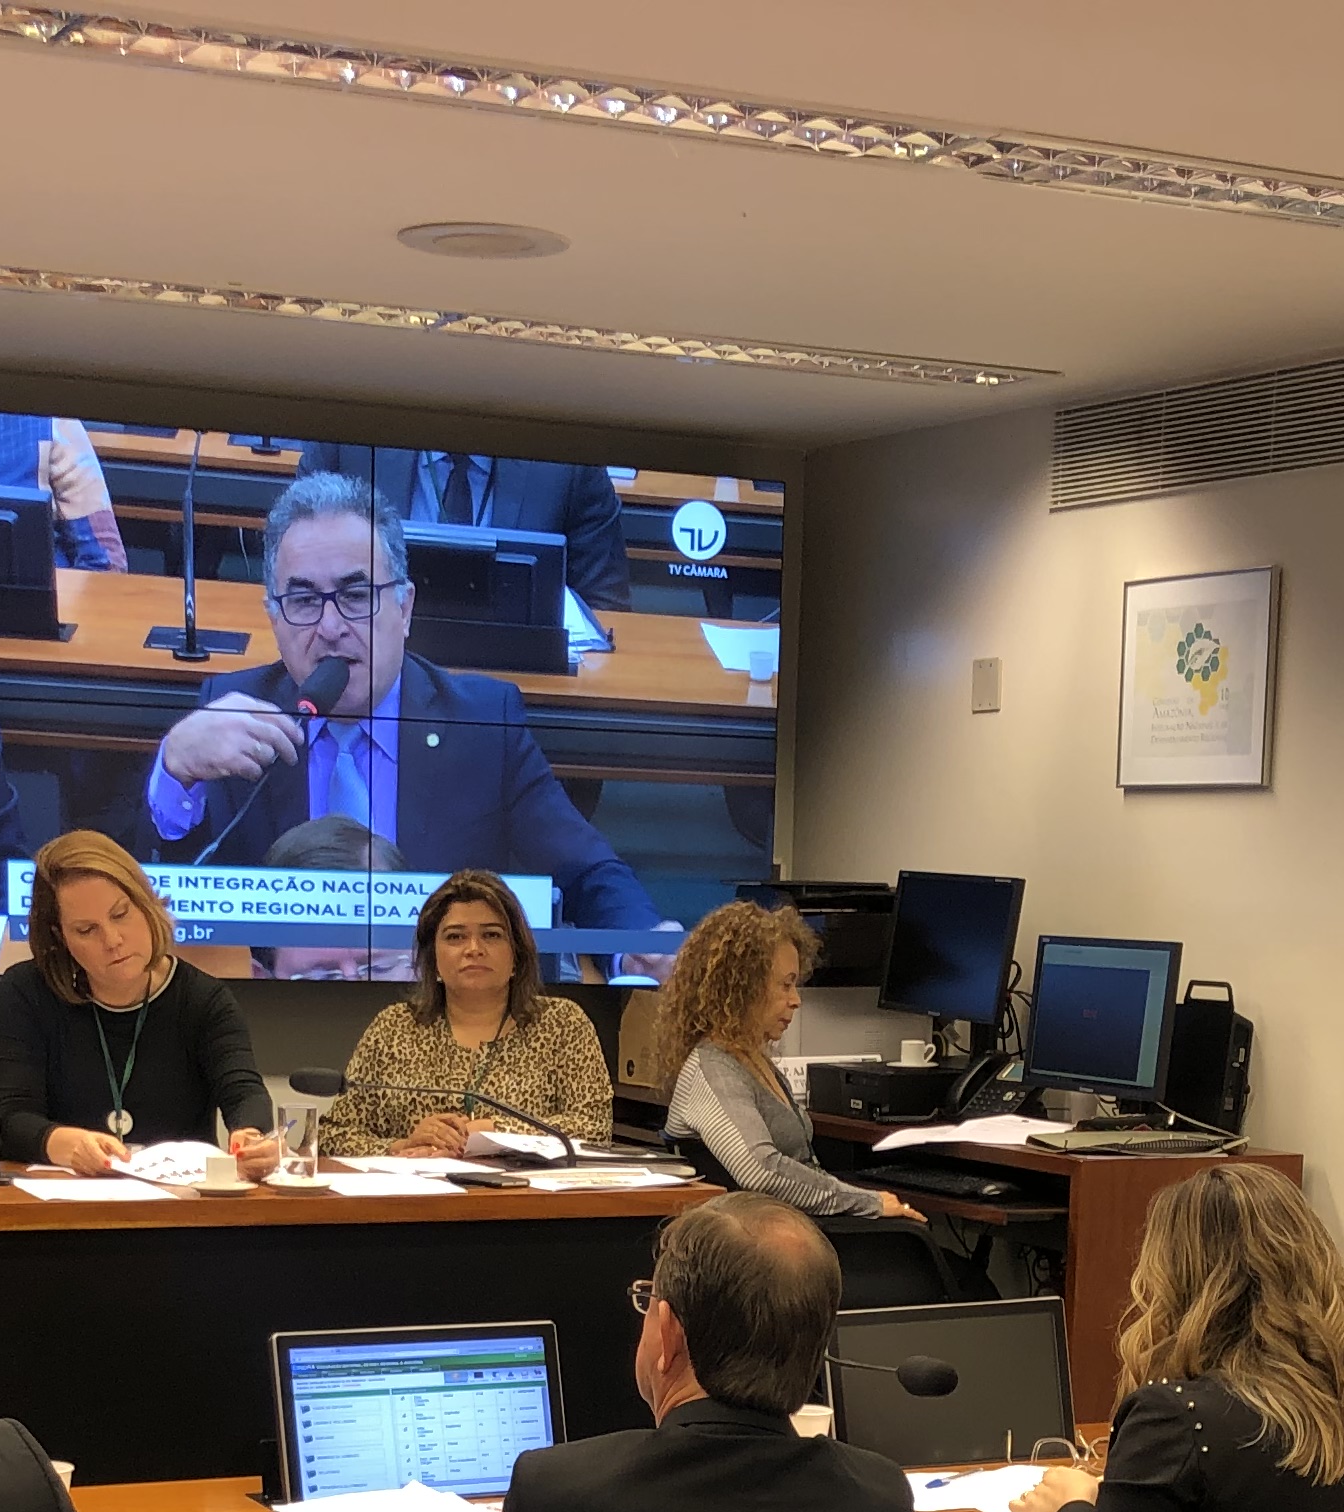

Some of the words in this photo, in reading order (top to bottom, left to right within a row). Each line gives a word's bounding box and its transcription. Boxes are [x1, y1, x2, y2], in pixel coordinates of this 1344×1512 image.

[668, 563, 682, 576] TV
[682, 563, 729, 579] CÂMARA
[177, 875, 315, 893] INTEGRAÇÃO
[242, 901, 347, 917] REGIONAL
[354, 904, 365, 917] E
[374, 905, 401, 918] DA
